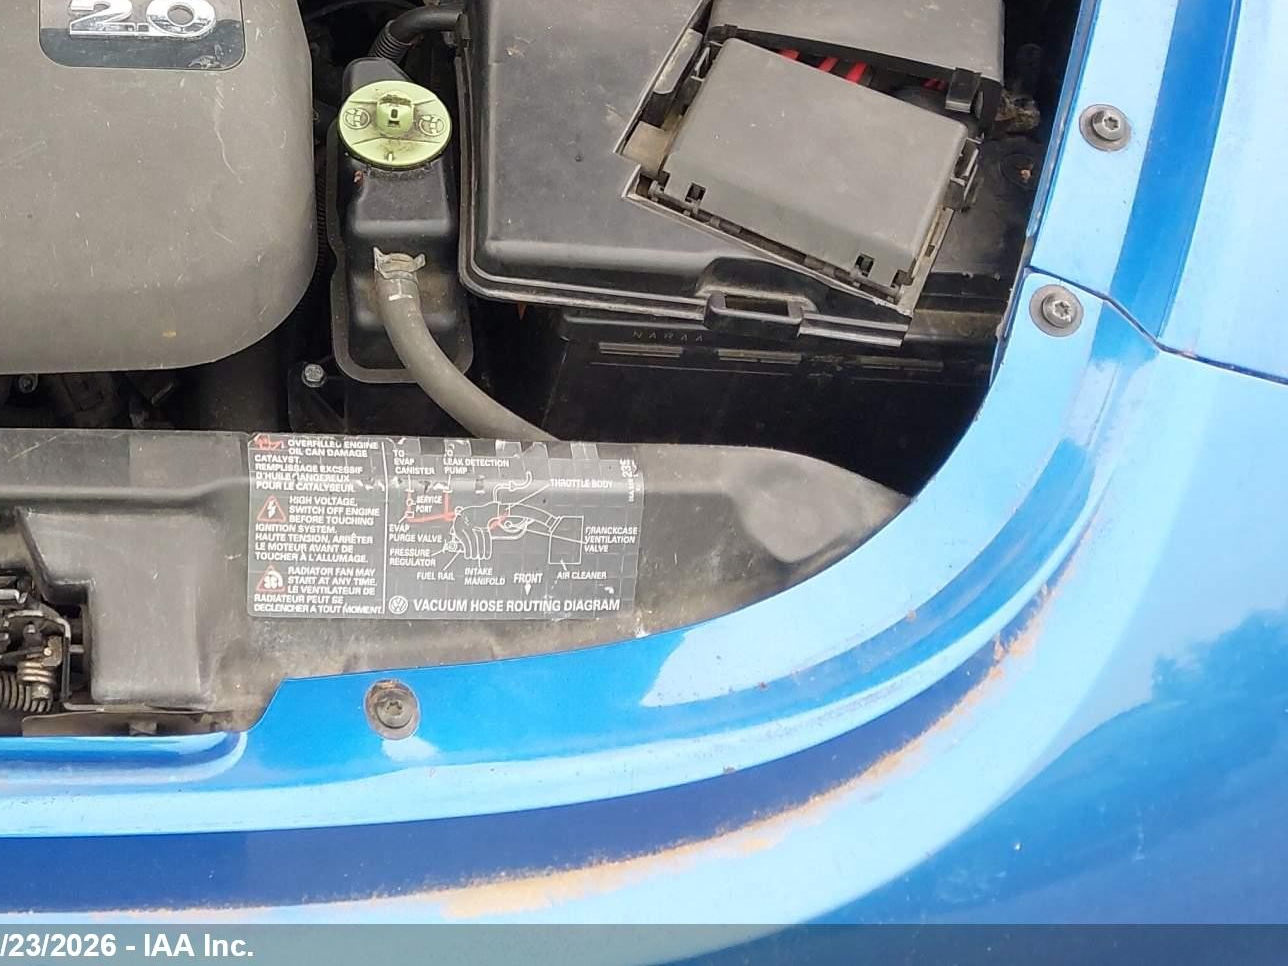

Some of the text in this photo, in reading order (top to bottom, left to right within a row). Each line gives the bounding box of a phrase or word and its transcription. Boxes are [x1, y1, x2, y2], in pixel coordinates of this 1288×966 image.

[344, 441, 378, 450] ENGINE
[327, 449, 368, 457] DAMAGE
[443, 457, 464, 466] LEAK
[465, 459, 510, 467] DETECTION
[255, 463, 363, 474] REMPLISSAGE EXCESSIF
[395, 467, 434, 475] CANISTER
[256, 481, 282, 490] POUR
[284, 482, 294, 491] LE
[550, 479, 613, 488] THROTTLE BODY
[289, 496, 312, 505] HIGH
[416, 495, 442, 504] SERVICE
[289, 505, 380, 516] SWITCH OFF ENGINE
[416, 505, 433, 513] PORT
[289, 515, 374, 525] BEFORE TOUCHING
[255, 524, 296, 532] IGNITION
[389, 524, 410, 533] EVAP
[255, 533, 287, 542] HAUTE
[388, 533, 442, 543] PURGE VALVE
[585, 535, 635, 544] VENTILATION
[255, 542, 354, 554] LE MOTEUR AVANT DE
[390, 548, 431, 557] PRESSURE
[584, 545, 609, 553] VALVE
[255, 552, 298, 561] TOUCHER
[390, 558, 436, 567] REGULATOR
[288, 567, 376, 577] RADIATOR FAN MAY
[464, 567, 493, 576] INTAKE
[572, 572, 607, 580] CLEANER
[288, 576, 318, 584] START
[319, 577, 331, 585] AT
[332, 577, 351, 586] ANY
[416, 572, 455, 581] FUEL RAIL
[513, 573, 543, 584] FRONT
[464, 577, 506, 586] MANIFOLD
[288, 585, 376, 595] LE VENTILATEUR DE
[254, 594, 344, 604] RADIATEUR PEUT SE
[318, 605, 341, 614] TOUT
[413, 599, 620, 612] VACUUM HOSE ROUTING DIAGRAM
